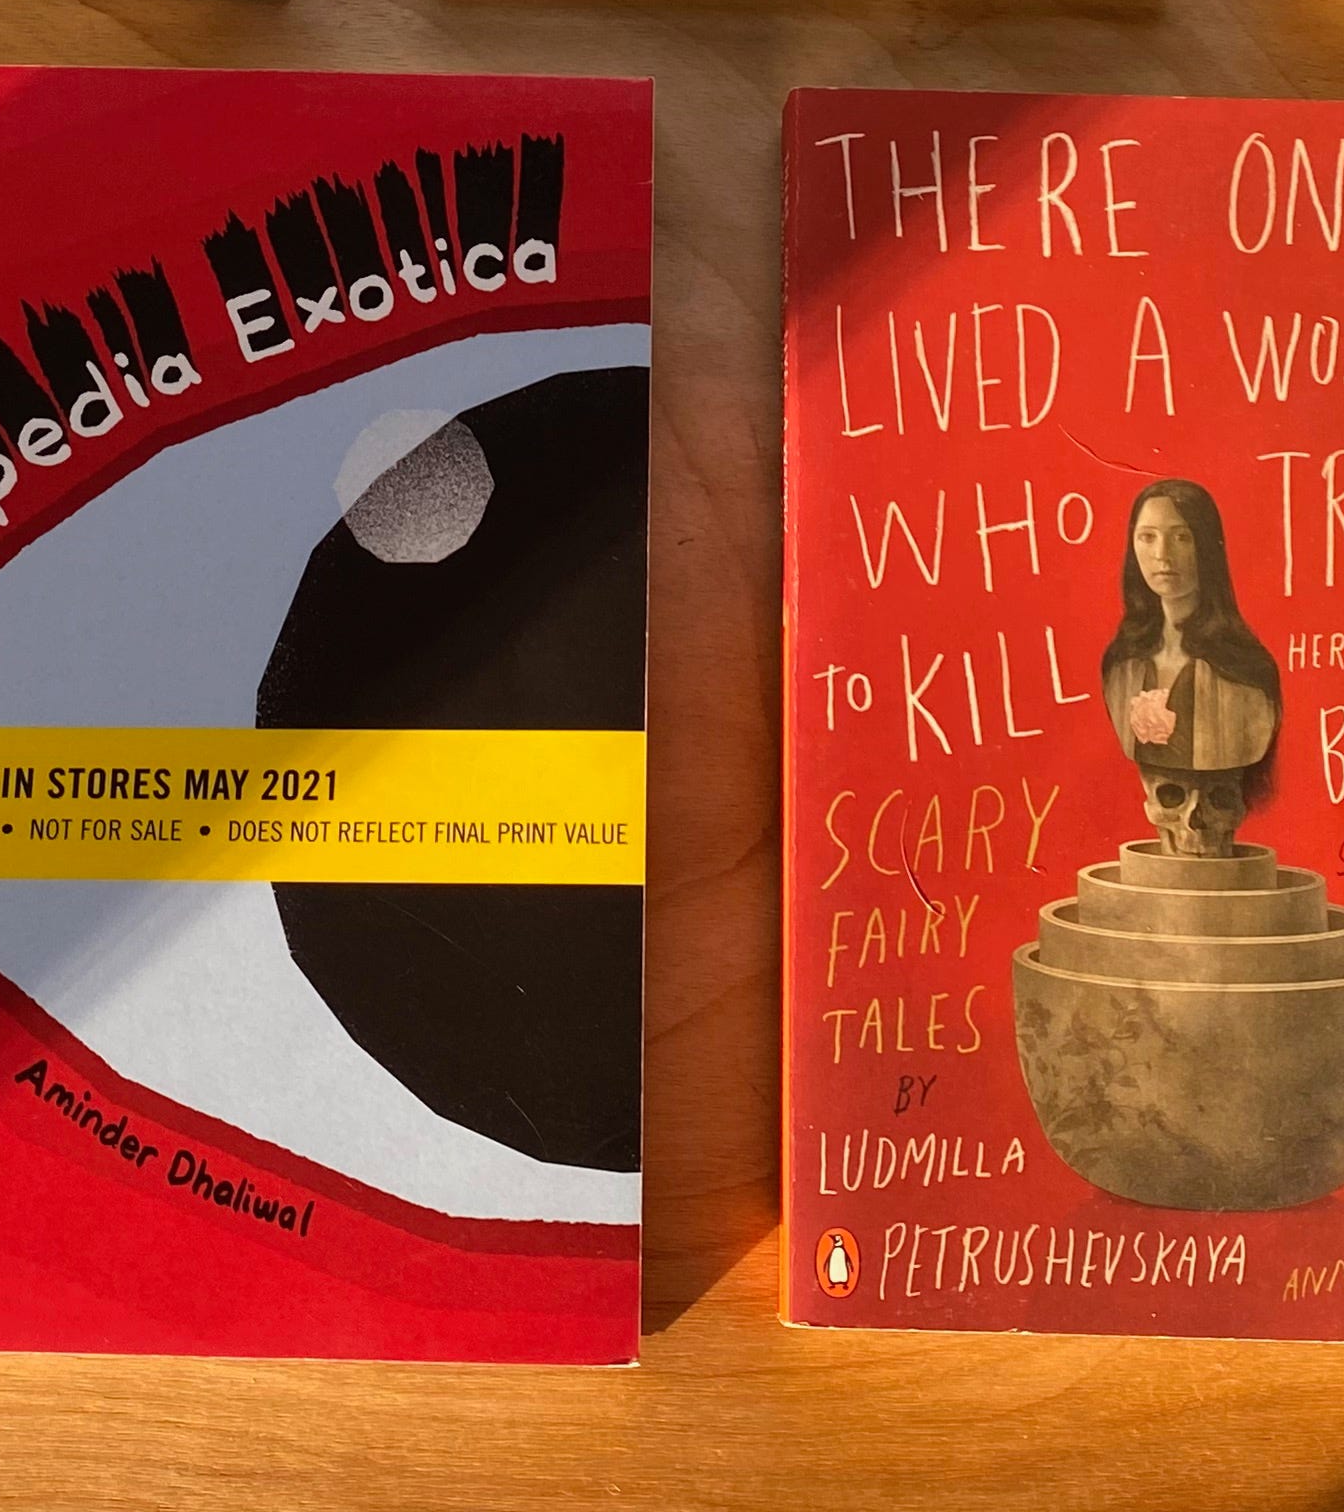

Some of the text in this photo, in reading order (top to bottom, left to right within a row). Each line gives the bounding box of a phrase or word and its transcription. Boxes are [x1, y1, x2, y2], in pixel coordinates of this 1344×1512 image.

[815, 129, 1150, 259] THERE
[225, 237, 559, 364] Exotica
[834, 301, 1062, 438] LIVED
[1124, 295, 1177, 417] A
[849, 478, 1096, 594] WHO
[899, 626, 1093, 764] KILL
[2, 767, 339, 803] IN STORES MAY 2021
[29, 818, 72, 842] NOT
[80, 818, 124, 842] FOR
[131, 819, 183, 842] SALE
[228, 819, 284, 843] DOES
[290, 820, 332, 844] NOT
[338, 820, 428, 845] REFLECT
[434, 821, 492, 845] FINAL
[497, 821, 560, 846] PRINT
[566, 822, 630, 847] VALUE
[820, 777, 1061, 890] SCARY
[826, 894, 981, 989] FAIRY
[822, 985, 983, 1065] TALES
[893, 1073, 938, 1117] BY
[14, 1056, 317, 1239] Aminder Dhaliwal
[817, 1130, 1027, 1197] LUDMILLA
[878, 1219, 1250, 1302] PETRUSHEVSKAYA
